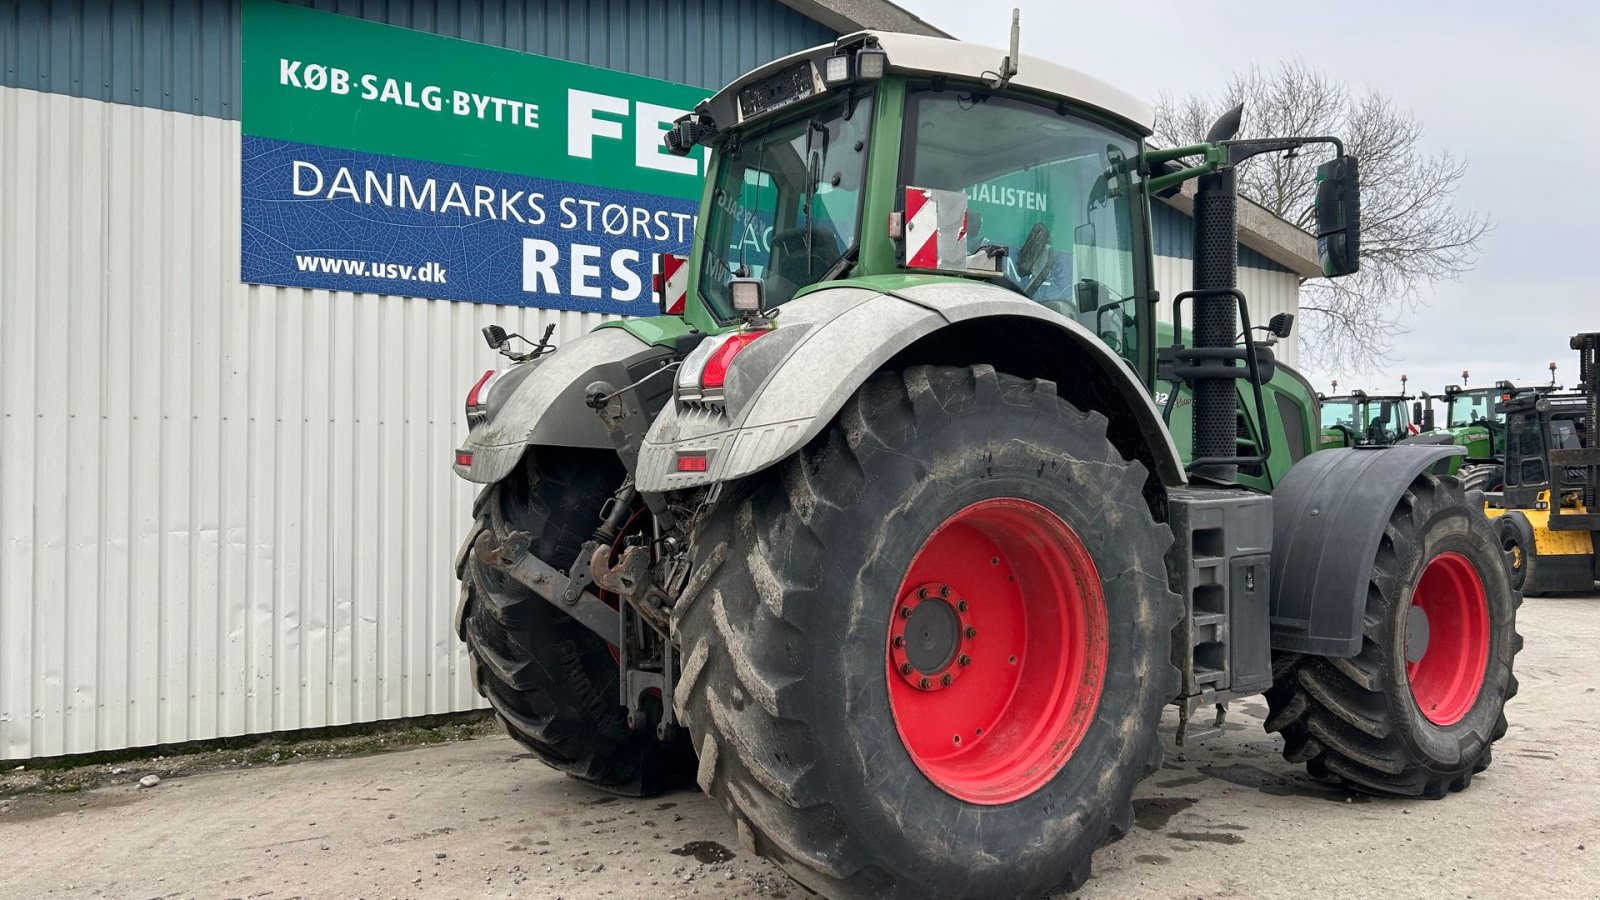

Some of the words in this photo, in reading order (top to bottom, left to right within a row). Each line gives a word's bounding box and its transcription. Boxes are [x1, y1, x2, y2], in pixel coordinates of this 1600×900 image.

[567, 88, 714, 178] FE
[293, 160, 546, 225] DANMARKS
[559, 196, 698, 243] STØRST
[295, 255, 447, 283] www.usv.dk
